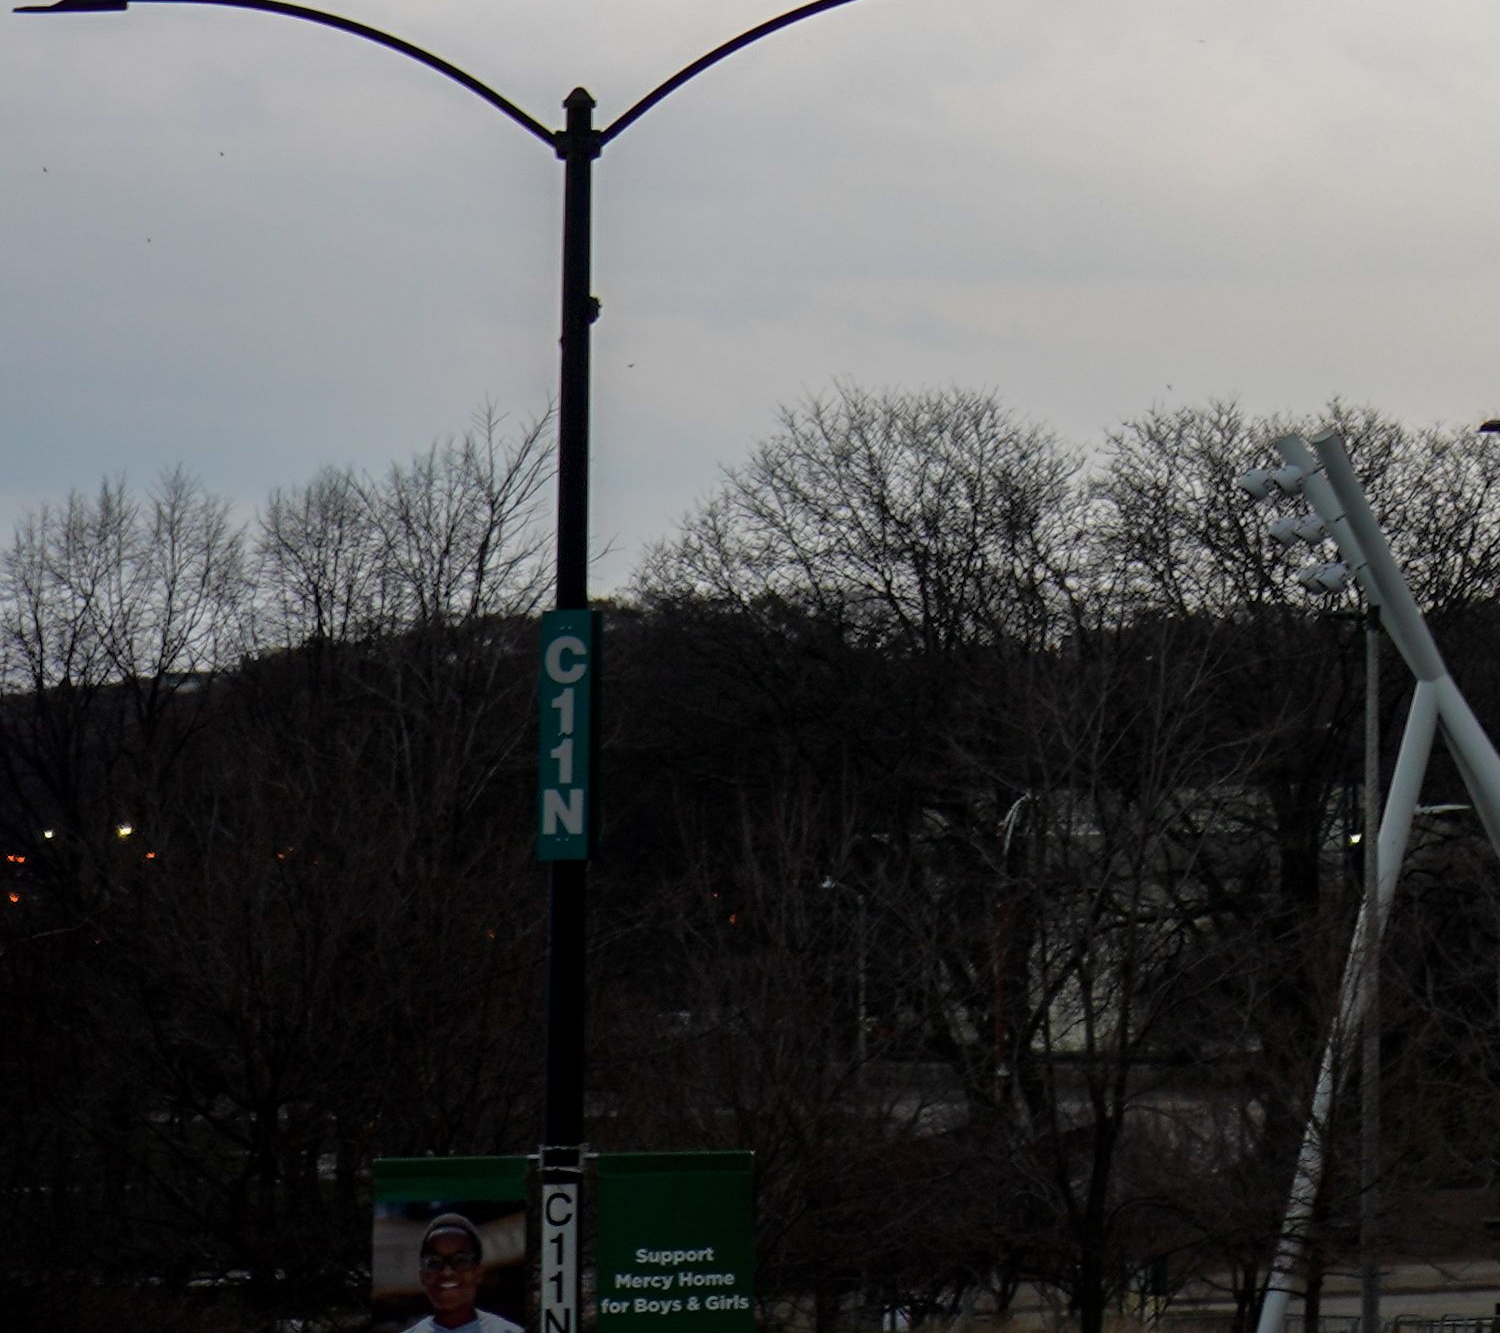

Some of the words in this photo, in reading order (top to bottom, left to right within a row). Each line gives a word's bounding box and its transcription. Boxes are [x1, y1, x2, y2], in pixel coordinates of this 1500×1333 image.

[542, 635, 588, 835] C11N
[546, 1192, 573, 1333] C11N
[635, 1246, 716, 1266] Support
[614, 1273, 675, 1290] Mercy
[678, 1271, 736, 1286] Home
[600, 1297, 630, 1314] for
[633, 1296, 683, 1315] Boys
[686, 1296, 701, 1312] &
[704, 1294, 750, 1311] Girls
